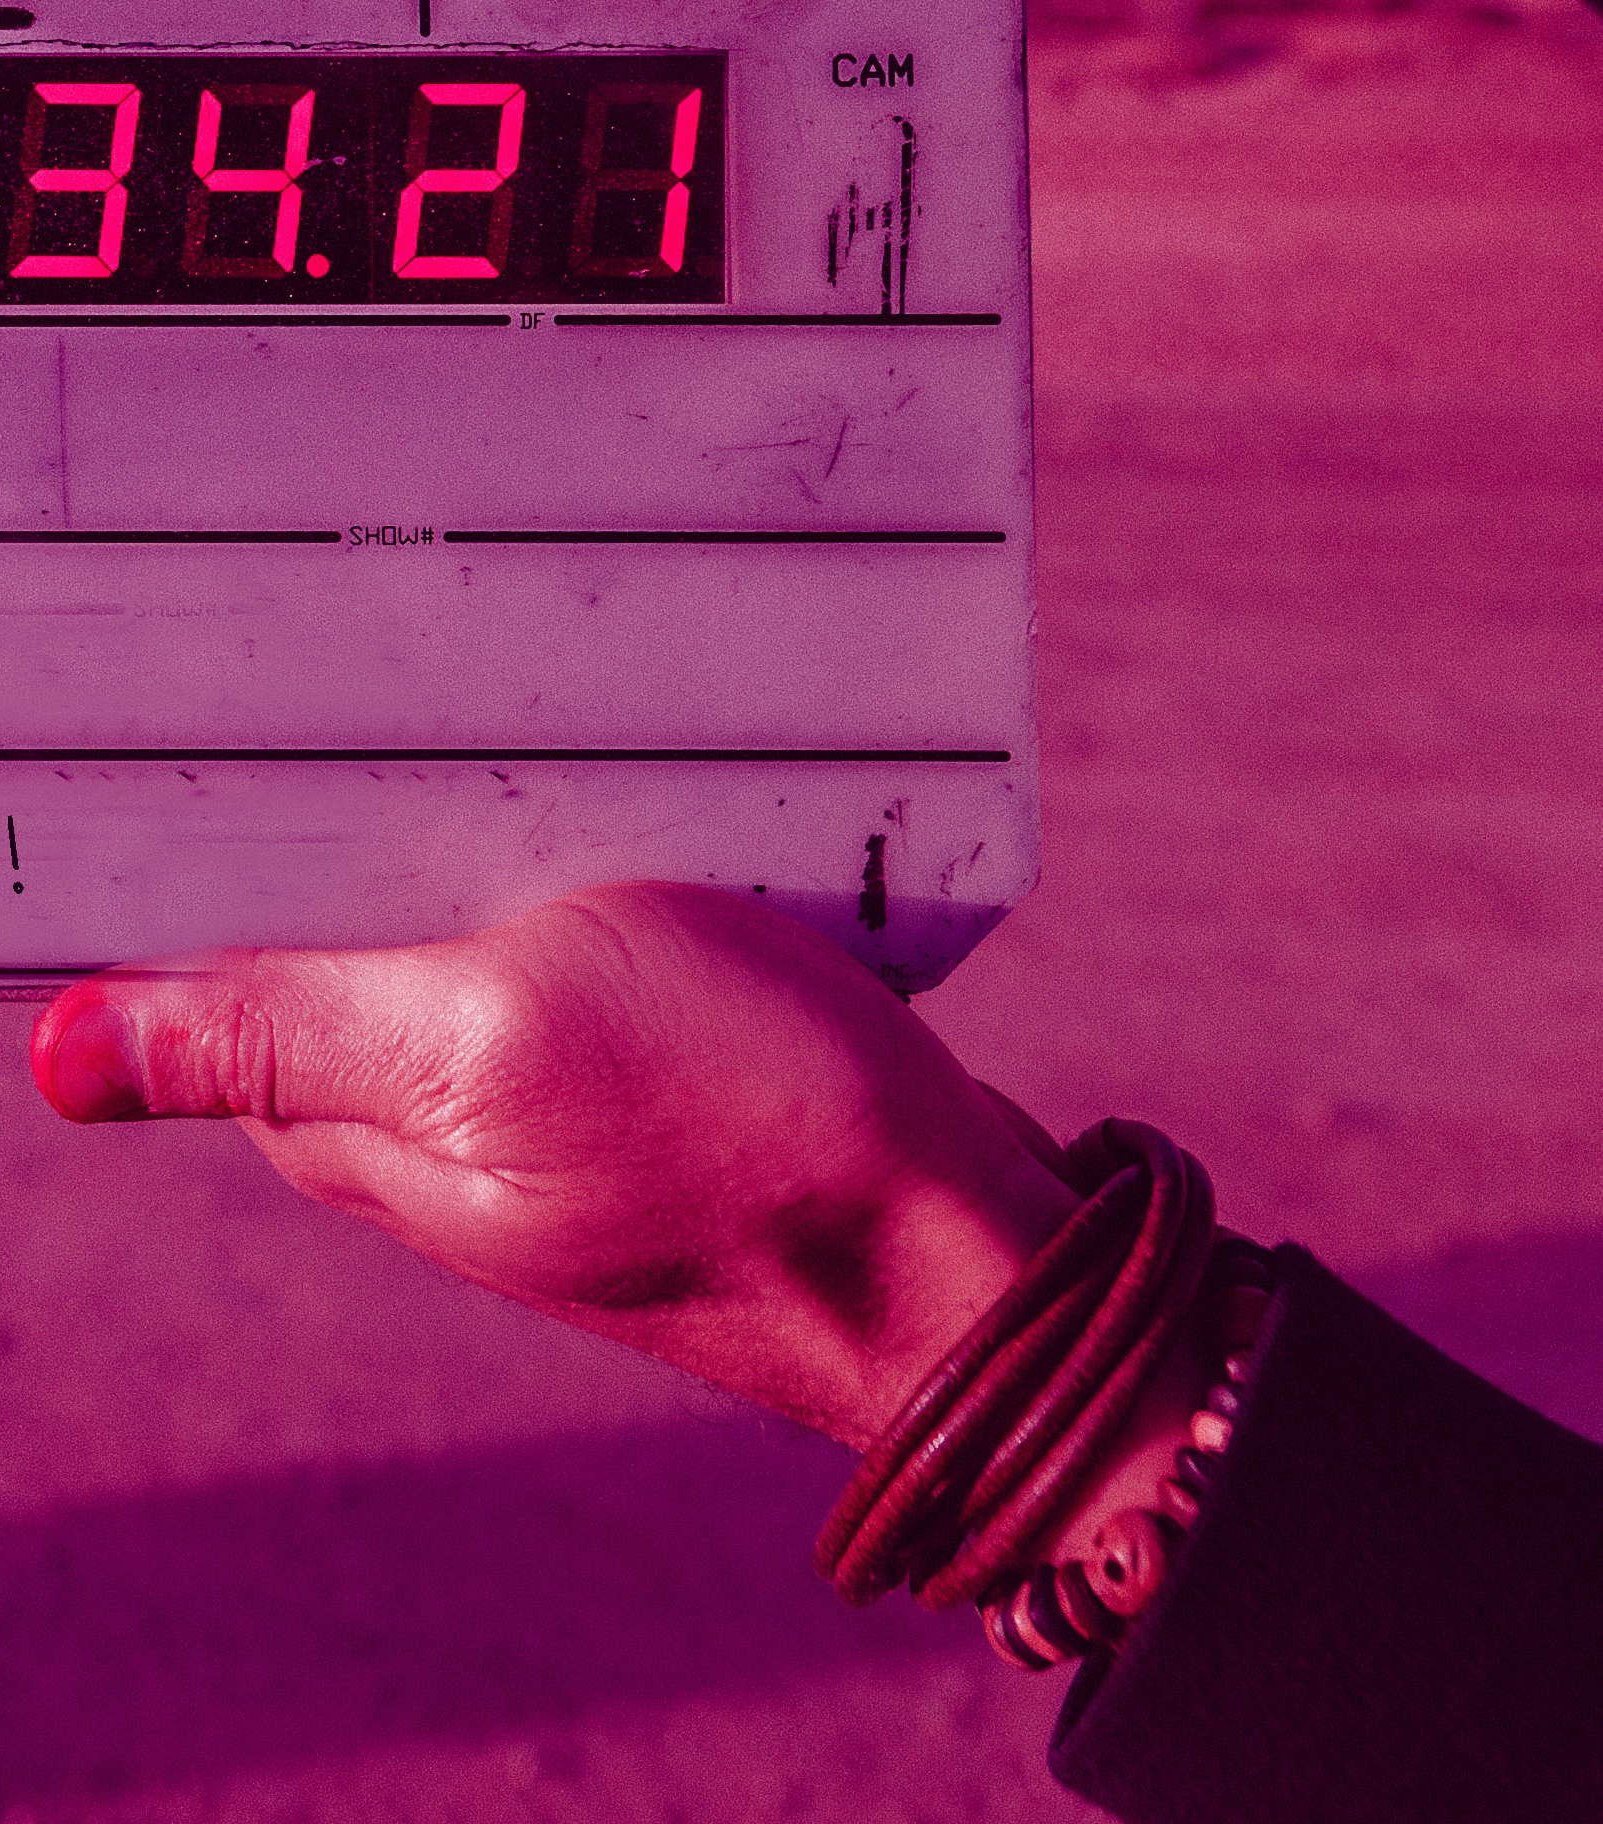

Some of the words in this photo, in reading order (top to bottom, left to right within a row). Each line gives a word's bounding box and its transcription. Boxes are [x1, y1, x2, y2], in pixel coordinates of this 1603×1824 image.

[831, 53, 914, 88] CAM
[520, 312, 546, 331] DF
[348, 525, 435, 547] SHOW#
